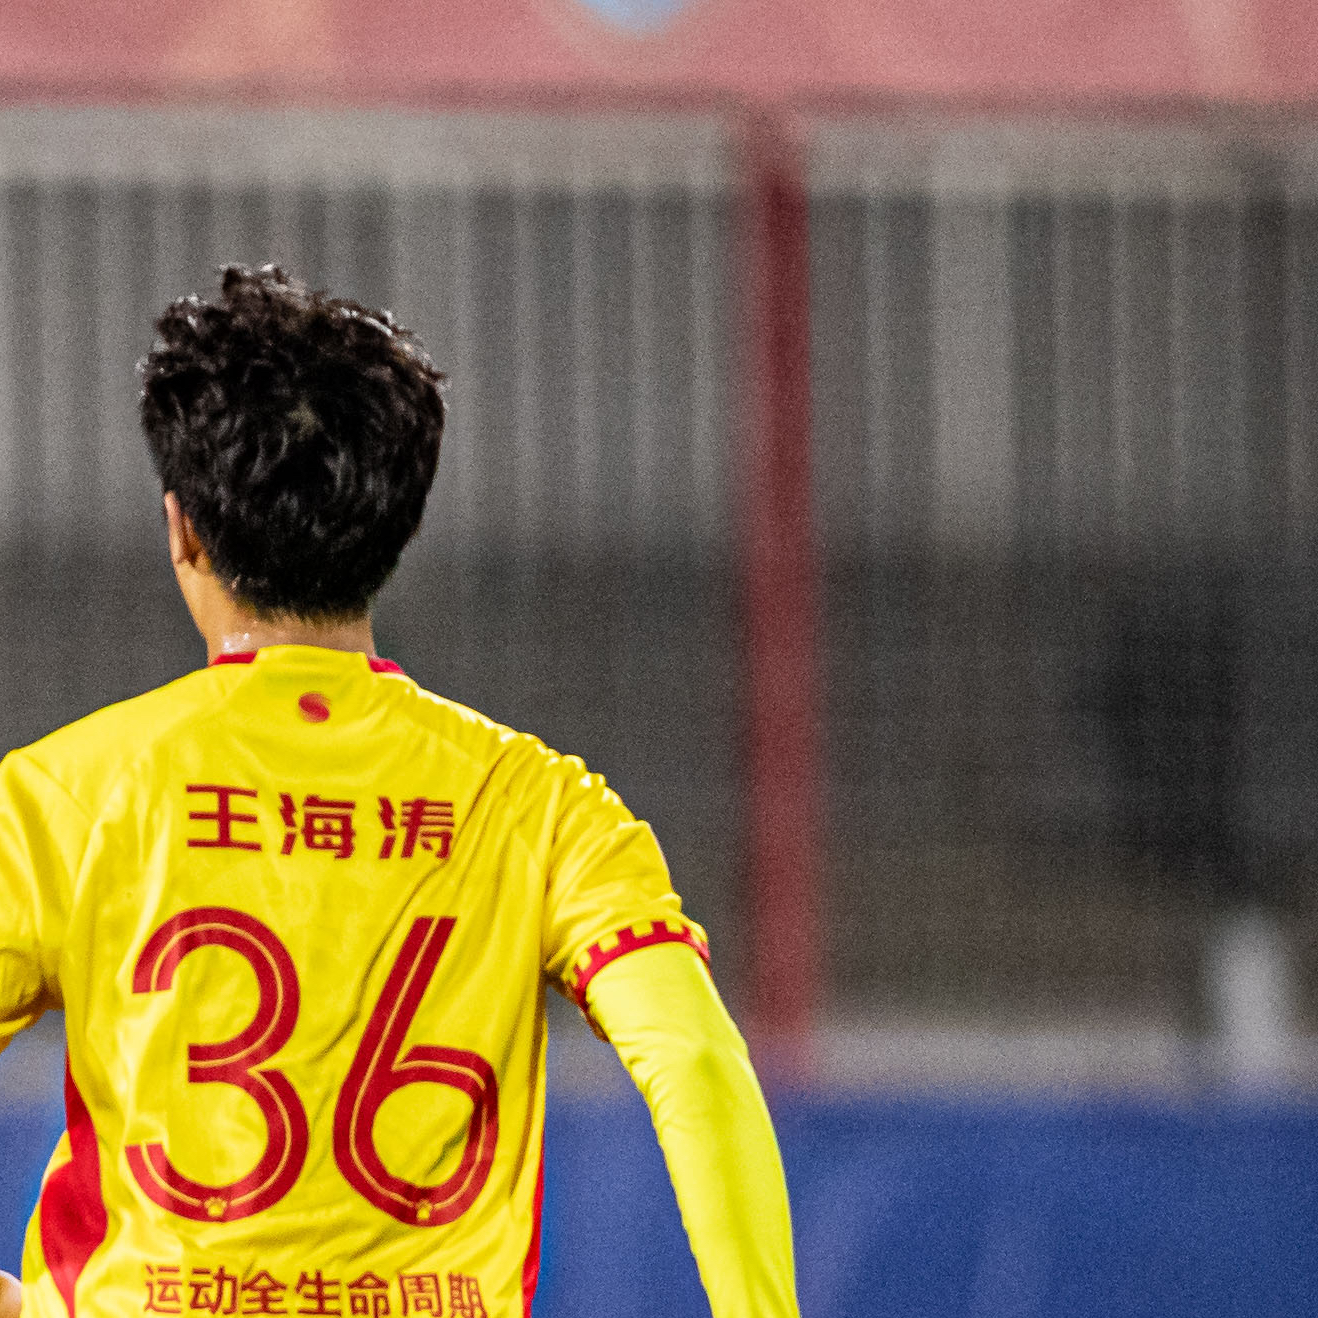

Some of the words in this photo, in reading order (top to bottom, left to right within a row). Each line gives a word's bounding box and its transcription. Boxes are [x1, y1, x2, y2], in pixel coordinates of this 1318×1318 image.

[185, 784, 455, 860] 王海涛
[125, 906, 499, 1228] 36
